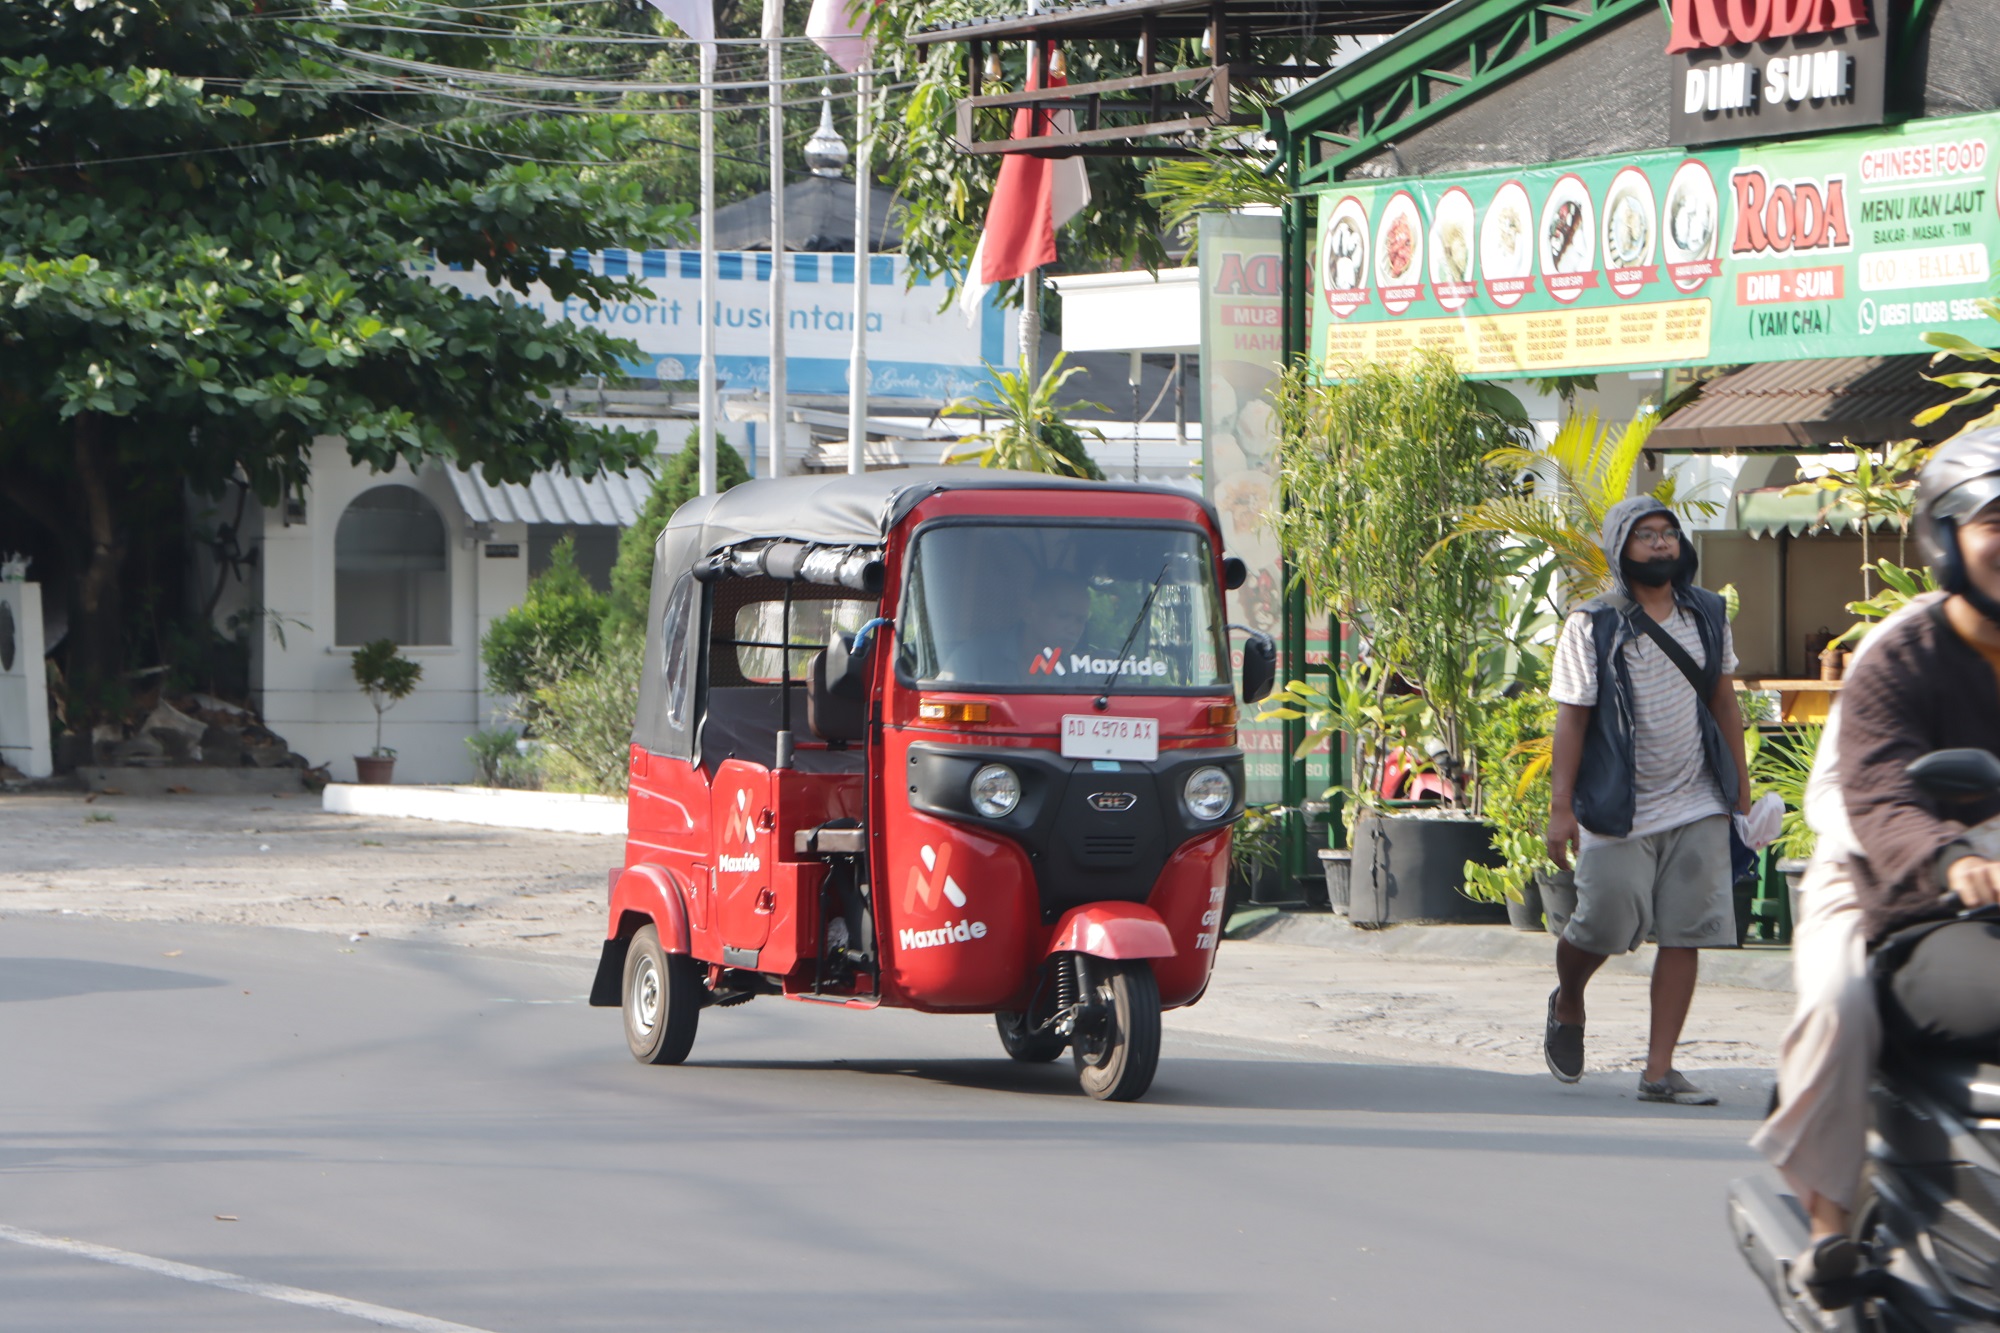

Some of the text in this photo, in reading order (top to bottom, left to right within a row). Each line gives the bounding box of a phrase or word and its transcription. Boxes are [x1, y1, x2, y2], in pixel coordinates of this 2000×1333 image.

[1684, 50, 1847, 113] DIM SUM
[1861, 142, 1986, 179] CHINESE FOOD
[1732, 170, 1850, 254] RODA
[1861, 190, 1986, 223] MENU IKAN LAUT
[1873, 228, 1906, 244] BAKAR
[1912, 225, 1945, 241] MASAK
[1952, 222, 1972, 238] TIM
[1919, 252, 1981, 280] HALAL
[1746, 273, 1781, 302] DIM
[1794, 270, 1835, 298] SUM
[563, 298, 682, 326] Favorit
[697, 300, 883, 332] Nusntara
[1070, 654, 1168, 676] Maxride
[1068, 720, 1085, 736] AD
[719, 852, 760, 872] Maxride
[899, 919, 987, 951] Maxride
